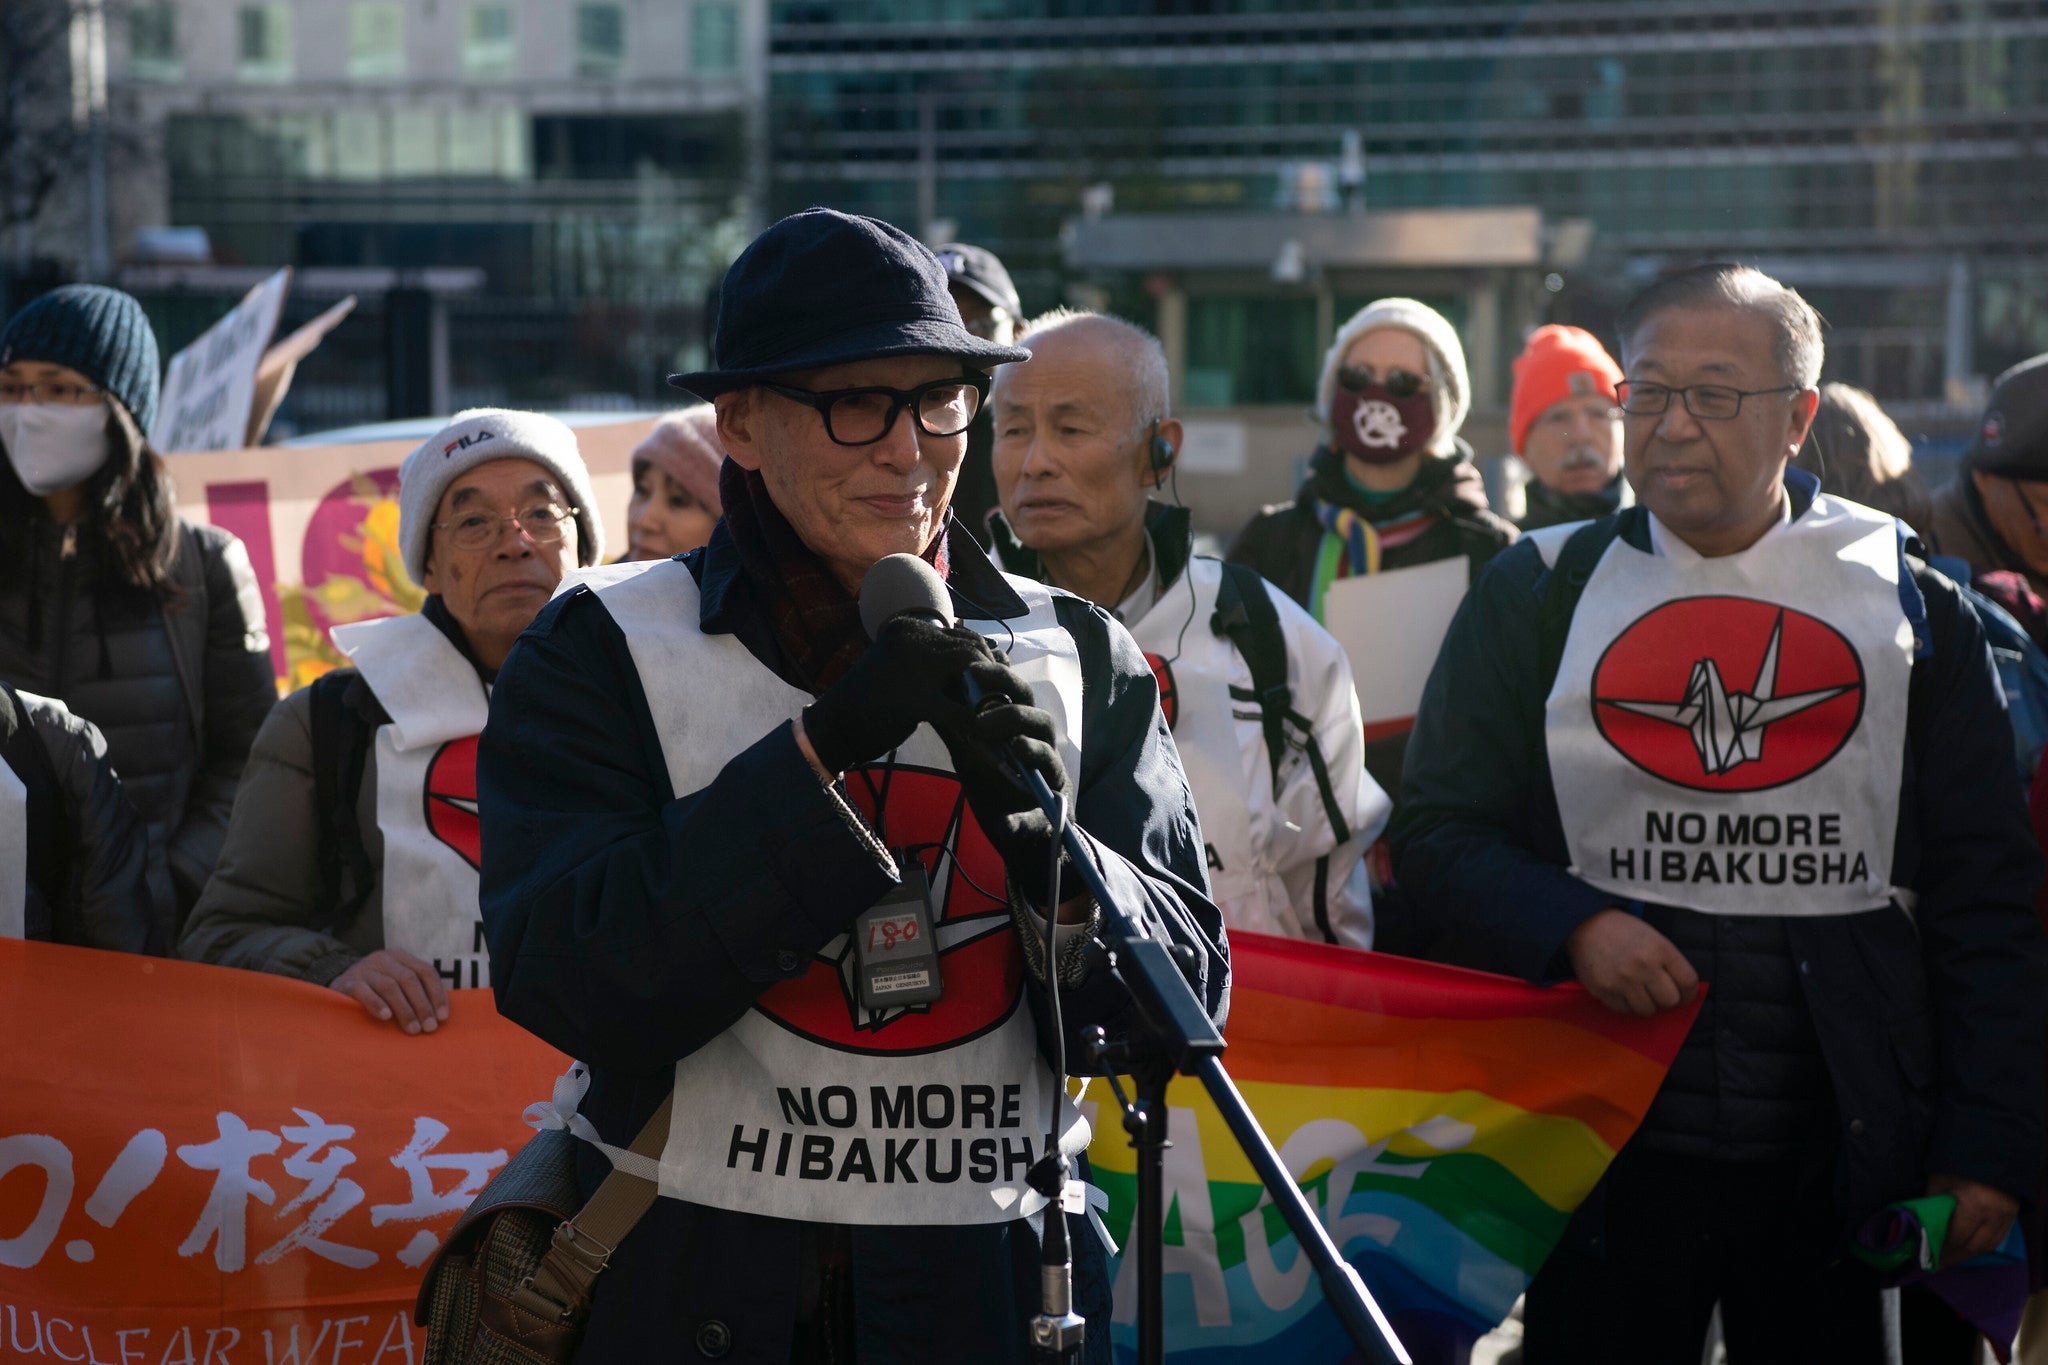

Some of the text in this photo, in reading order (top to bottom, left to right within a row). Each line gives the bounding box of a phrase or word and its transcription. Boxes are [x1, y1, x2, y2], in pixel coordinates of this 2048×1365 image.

[444, 431, 495, 458] FILA
[1646, 811, 1841, 846] NO MORE
[1610, 848, 1869, 885] HIBAKUSHA
[777, 1084, 1021, 1129] NO MORE
[0, 1303, 242, 1365] UCLEAR
